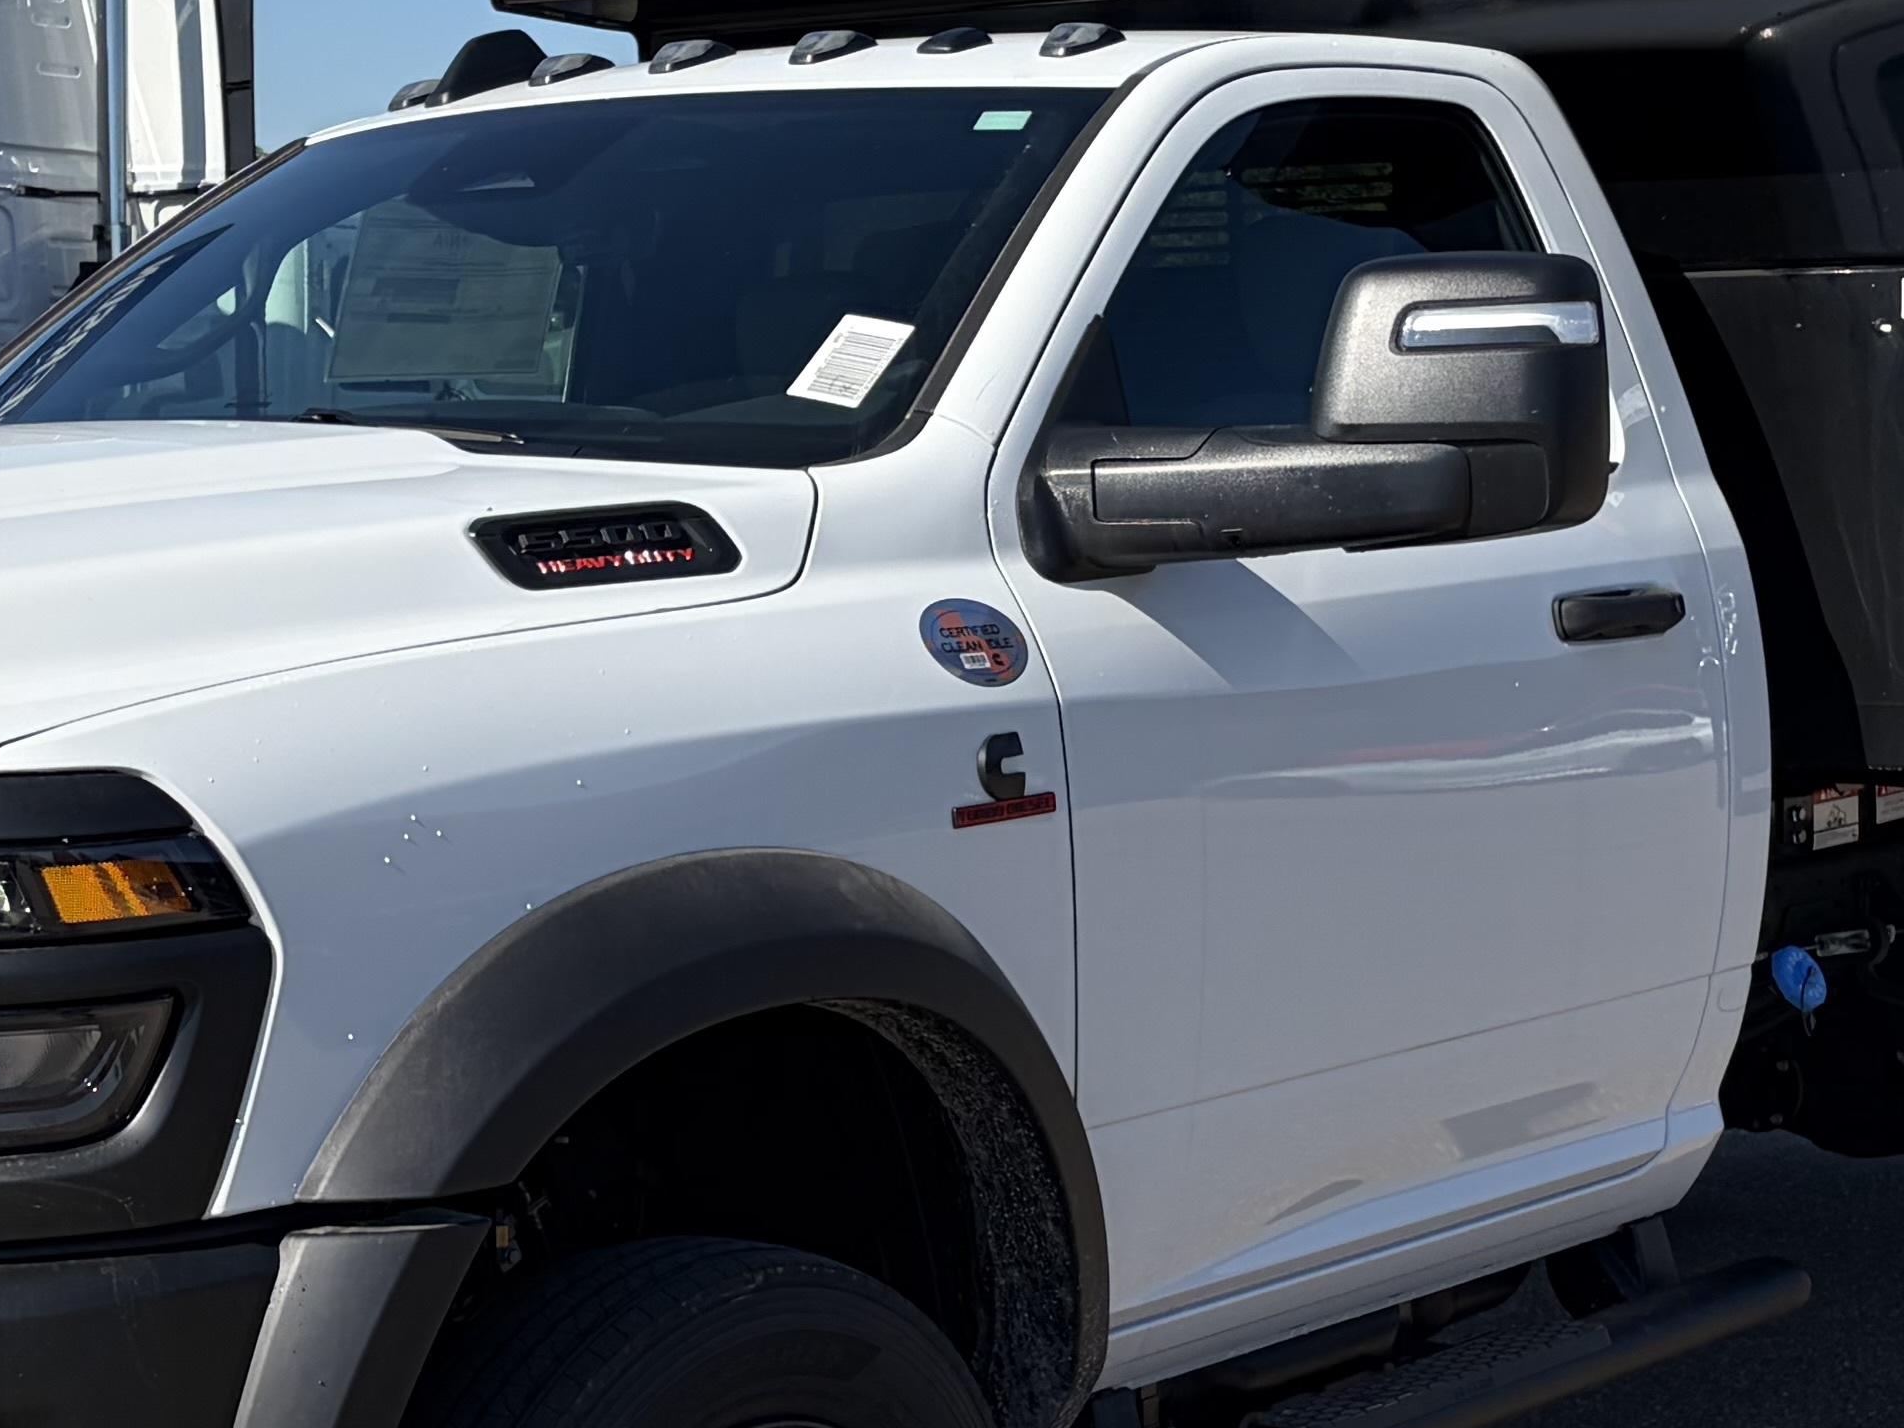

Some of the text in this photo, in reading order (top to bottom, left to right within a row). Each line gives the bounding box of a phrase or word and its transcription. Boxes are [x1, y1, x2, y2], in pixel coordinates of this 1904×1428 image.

[518, 523, 682, 554] 5500
[536, 547, 695, 574] HEAVY DUTY
[939, 624, 1001, 638] CERTIFIED
[941, 637, 1014, 653] CLEAN IDLE
